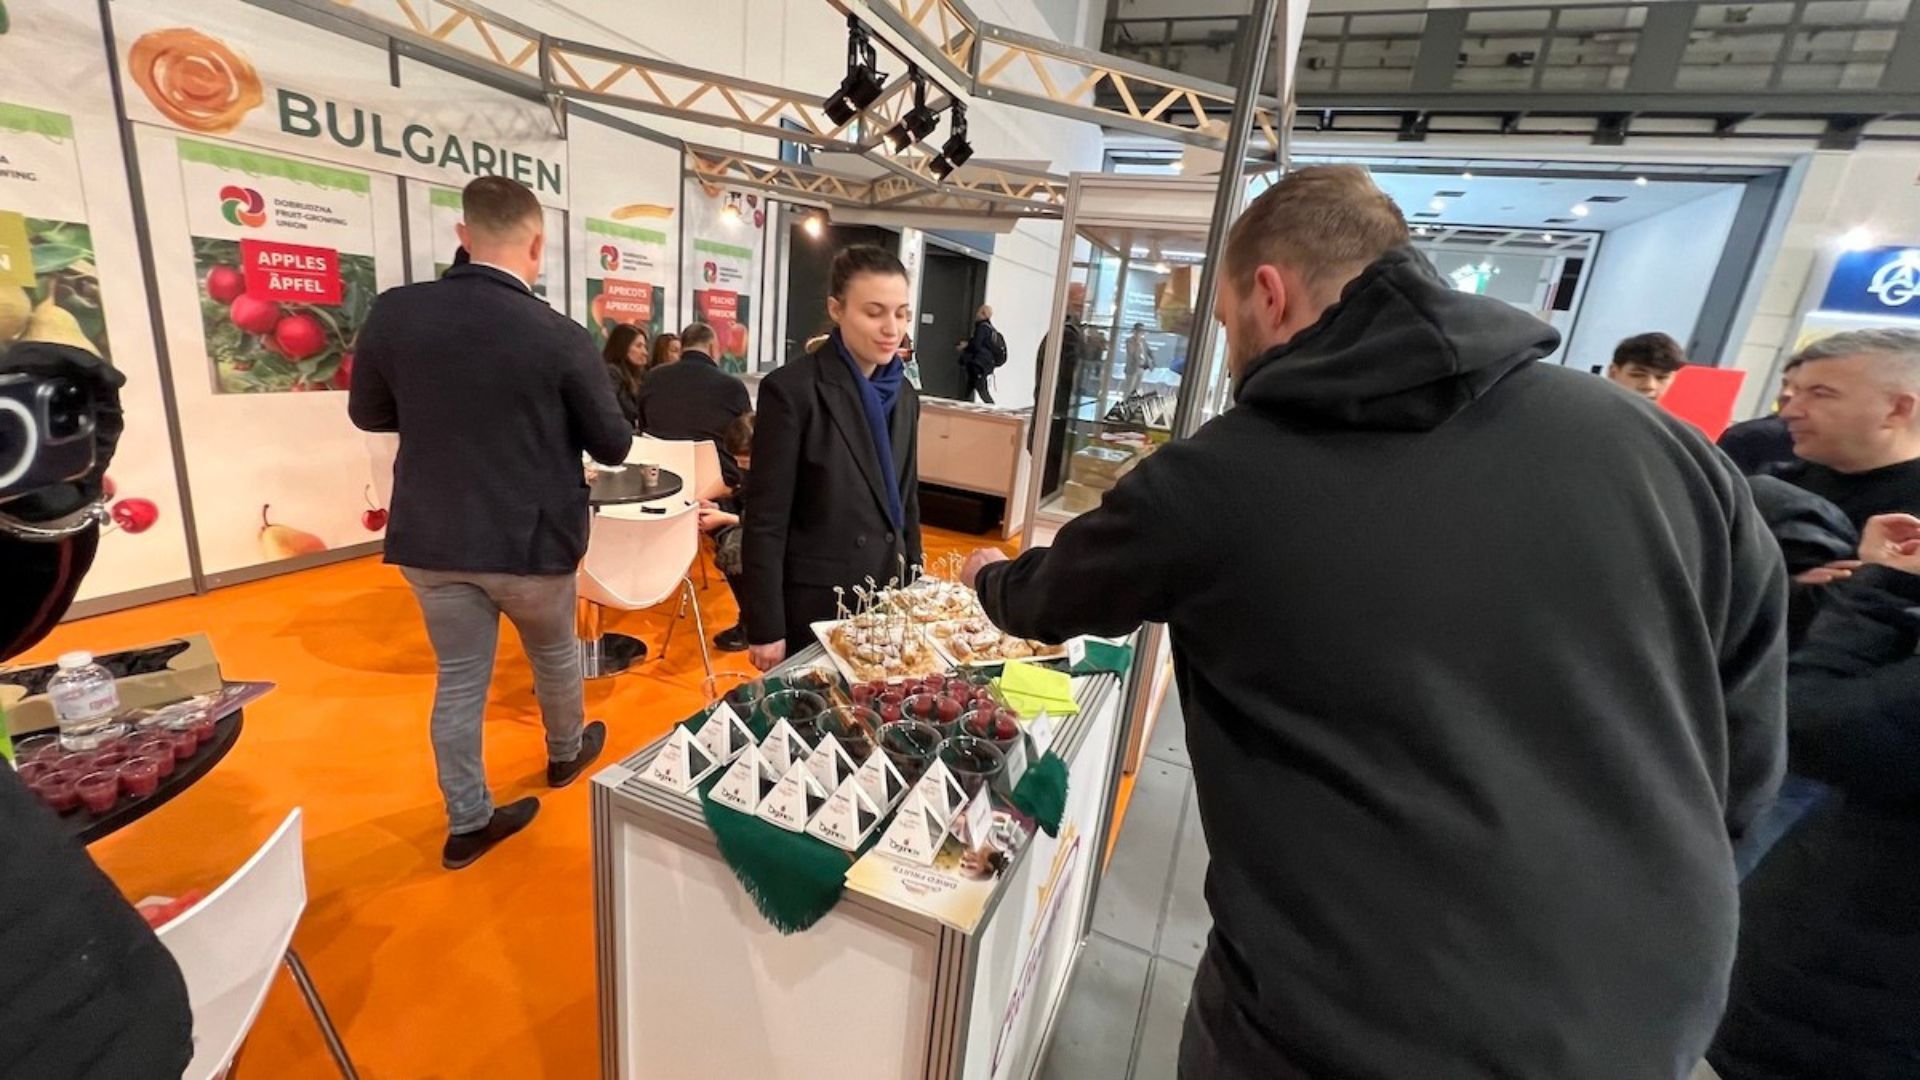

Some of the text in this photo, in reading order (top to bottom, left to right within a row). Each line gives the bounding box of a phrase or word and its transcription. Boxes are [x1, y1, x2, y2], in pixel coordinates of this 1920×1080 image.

[277, 88, 561, 194] BULGARIEN
[275, 210, 348, 225] FRUIT-GROWING
[276, 220, 307, 229] UNION
[258, 252, 326, 270] APPLES
[269, 272, 325, 293] ÄPFEL
[608, 285, 647, 298] APRICOTS
